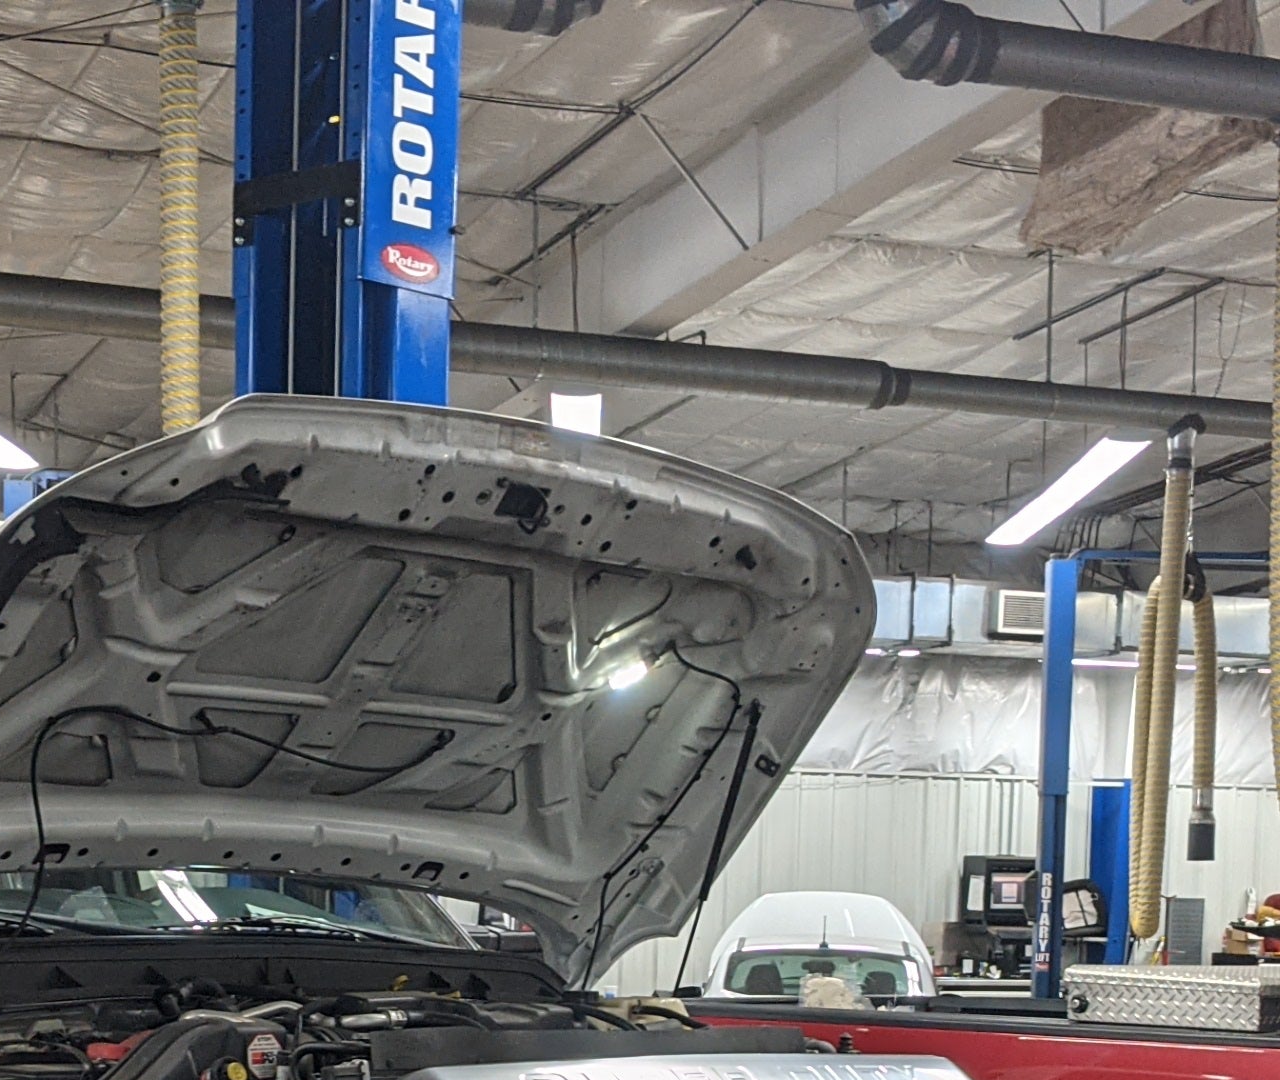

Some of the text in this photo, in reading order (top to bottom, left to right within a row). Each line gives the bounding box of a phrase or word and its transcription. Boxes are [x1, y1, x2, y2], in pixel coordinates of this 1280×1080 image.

[387, 246, 434, 276] Rotary
[1039, 872, 1053, 952] ROTARY
[1035, 953, 1050, 962] LIFT
